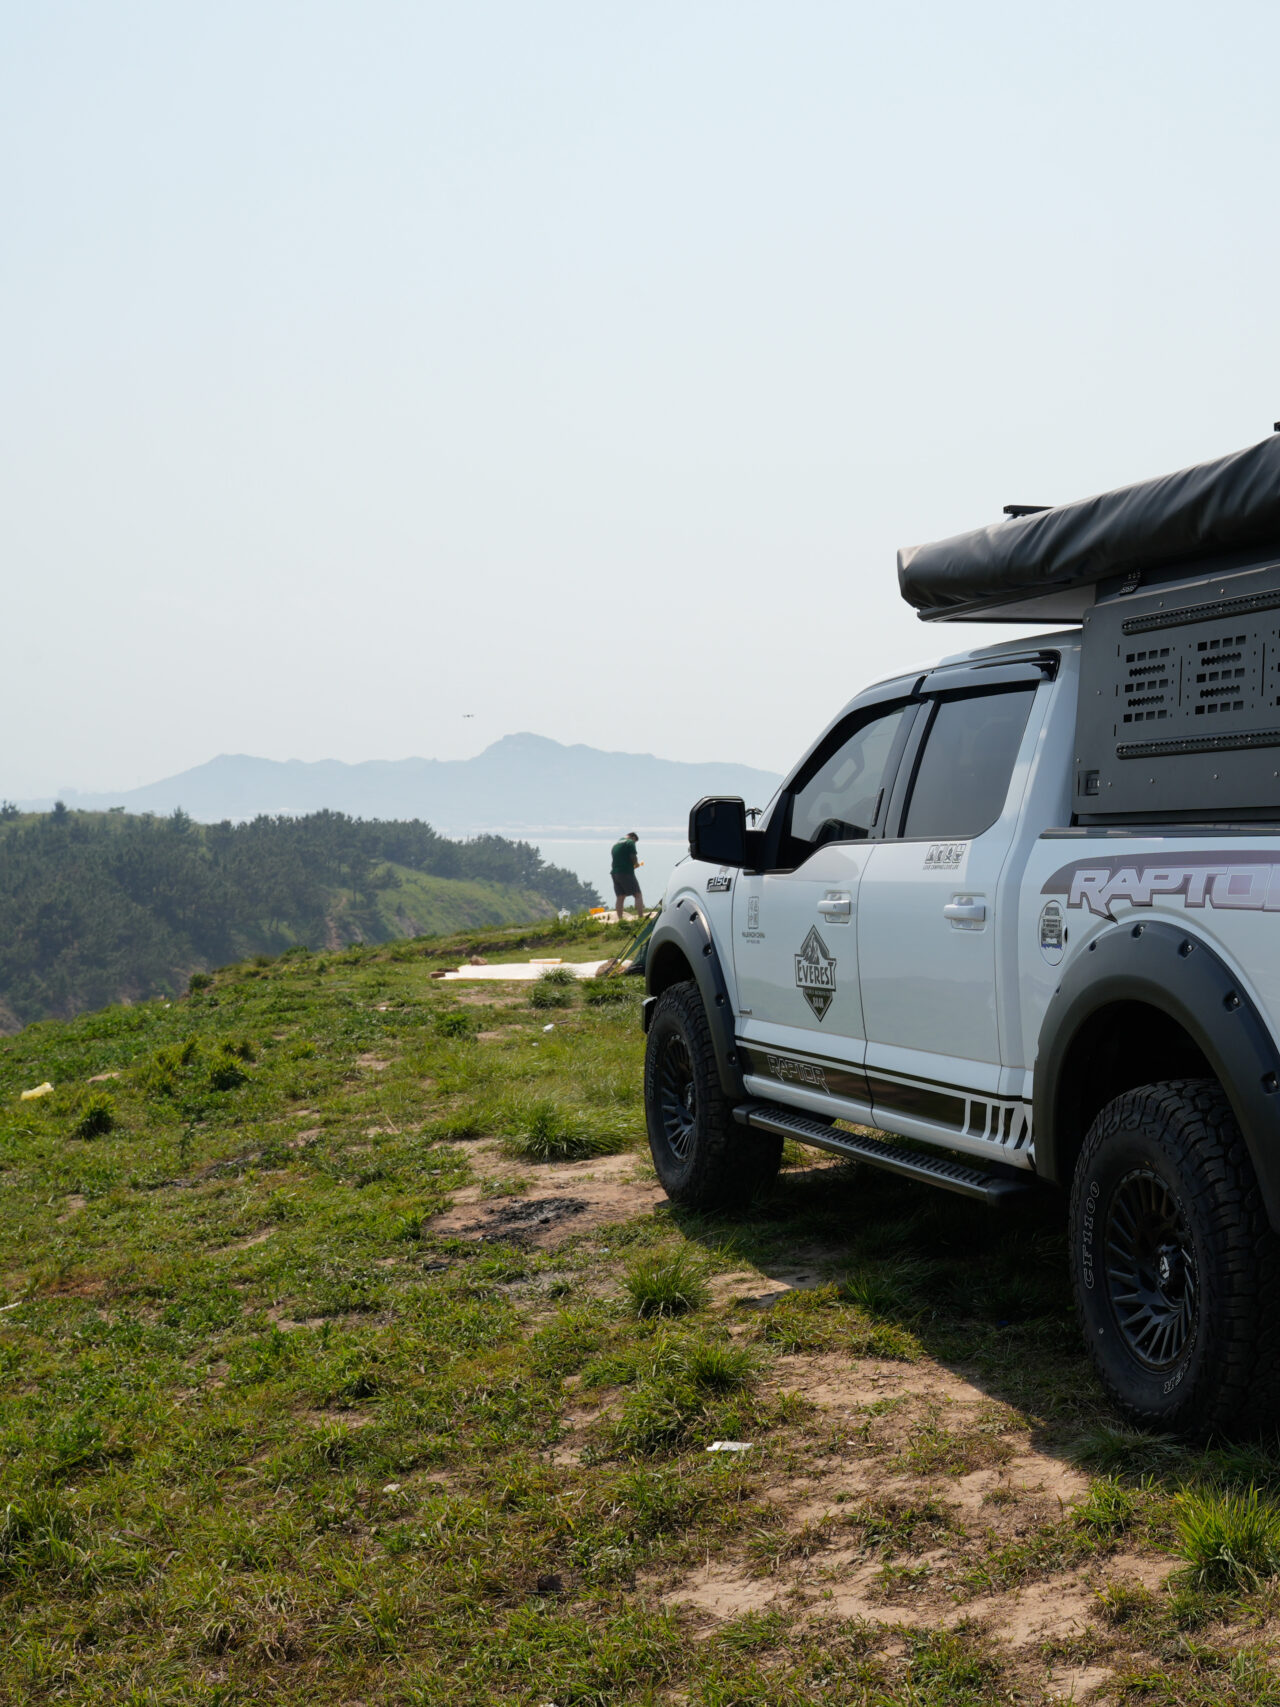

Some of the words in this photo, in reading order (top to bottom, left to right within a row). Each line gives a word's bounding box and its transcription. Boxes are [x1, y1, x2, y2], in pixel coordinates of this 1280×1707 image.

[797, 959, 834, 986] EVEREST
[767, 1055, 831, 1096] RAPTOR
[1082, 1180, 1100, 1290] CF1100
